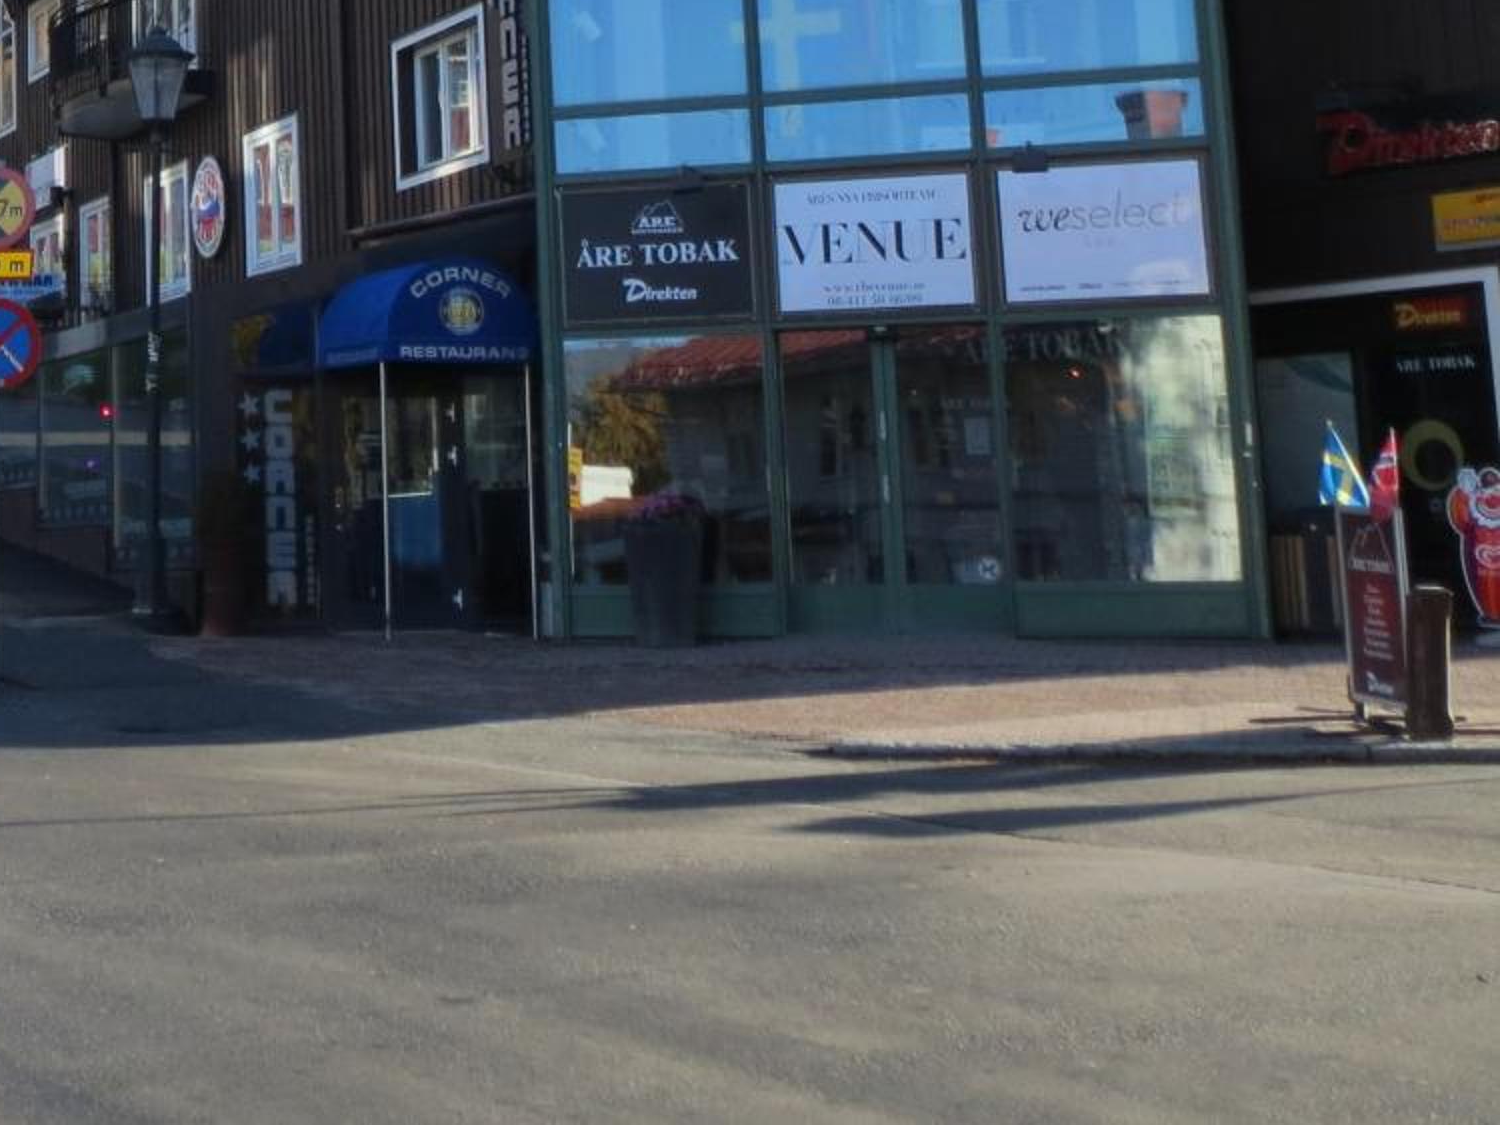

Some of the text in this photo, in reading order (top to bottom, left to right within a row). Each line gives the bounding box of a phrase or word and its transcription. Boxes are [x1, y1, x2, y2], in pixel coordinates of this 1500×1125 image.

[577, 238, 740, 268] ÅRE TOBAK
[779, 218, 967, 265] VENUE
[9, 260, 25, 272] m
[409, 266, 511, 299] CORNER
[622, 278, 698, 303] Direkten
